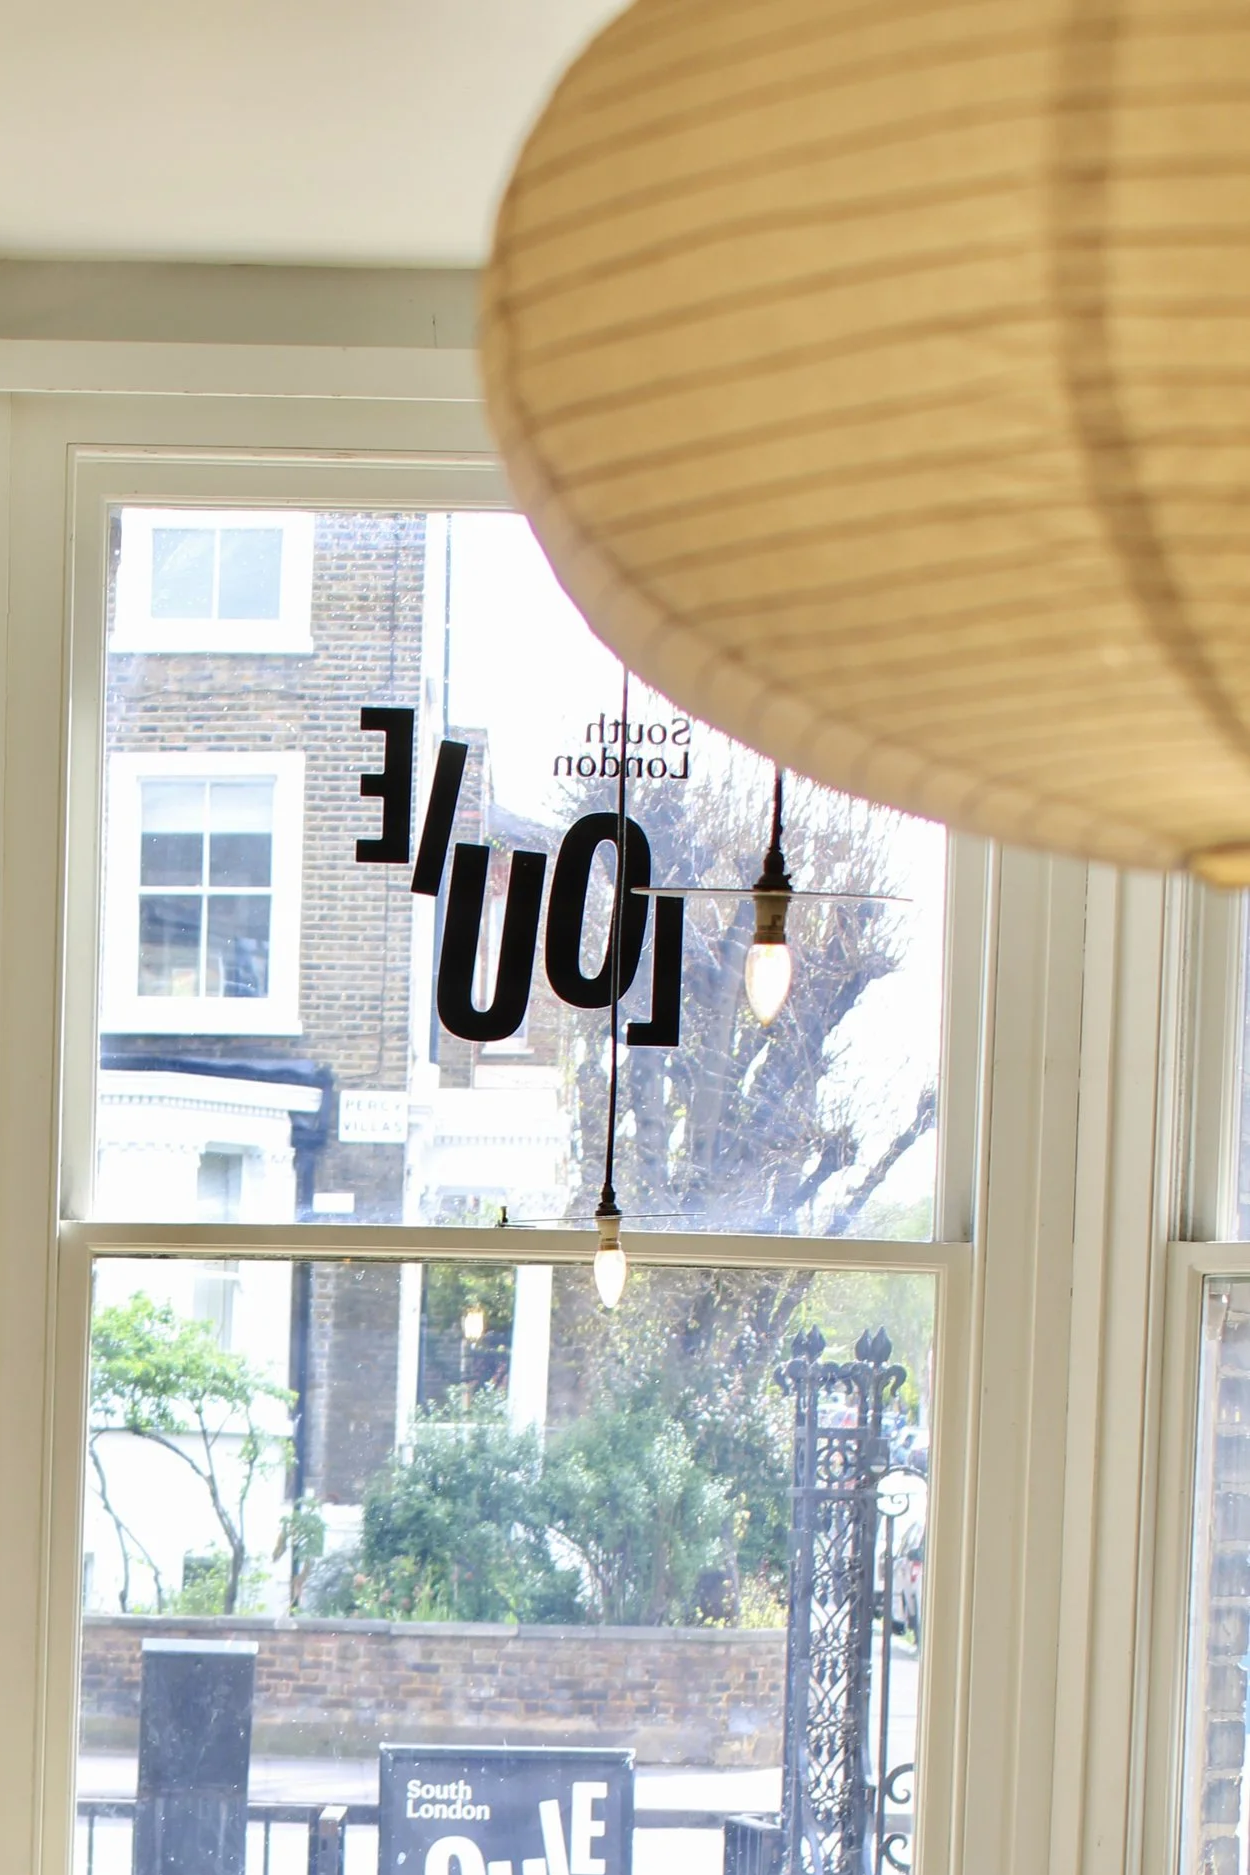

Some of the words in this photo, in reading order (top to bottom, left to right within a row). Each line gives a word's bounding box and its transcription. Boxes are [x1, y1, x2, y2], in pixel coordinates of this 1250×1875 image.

[343, 1120, 402, 1133] VILLAS
[406, 1779, 472, 1800] South
[406, 1799, 490, 1820] London
